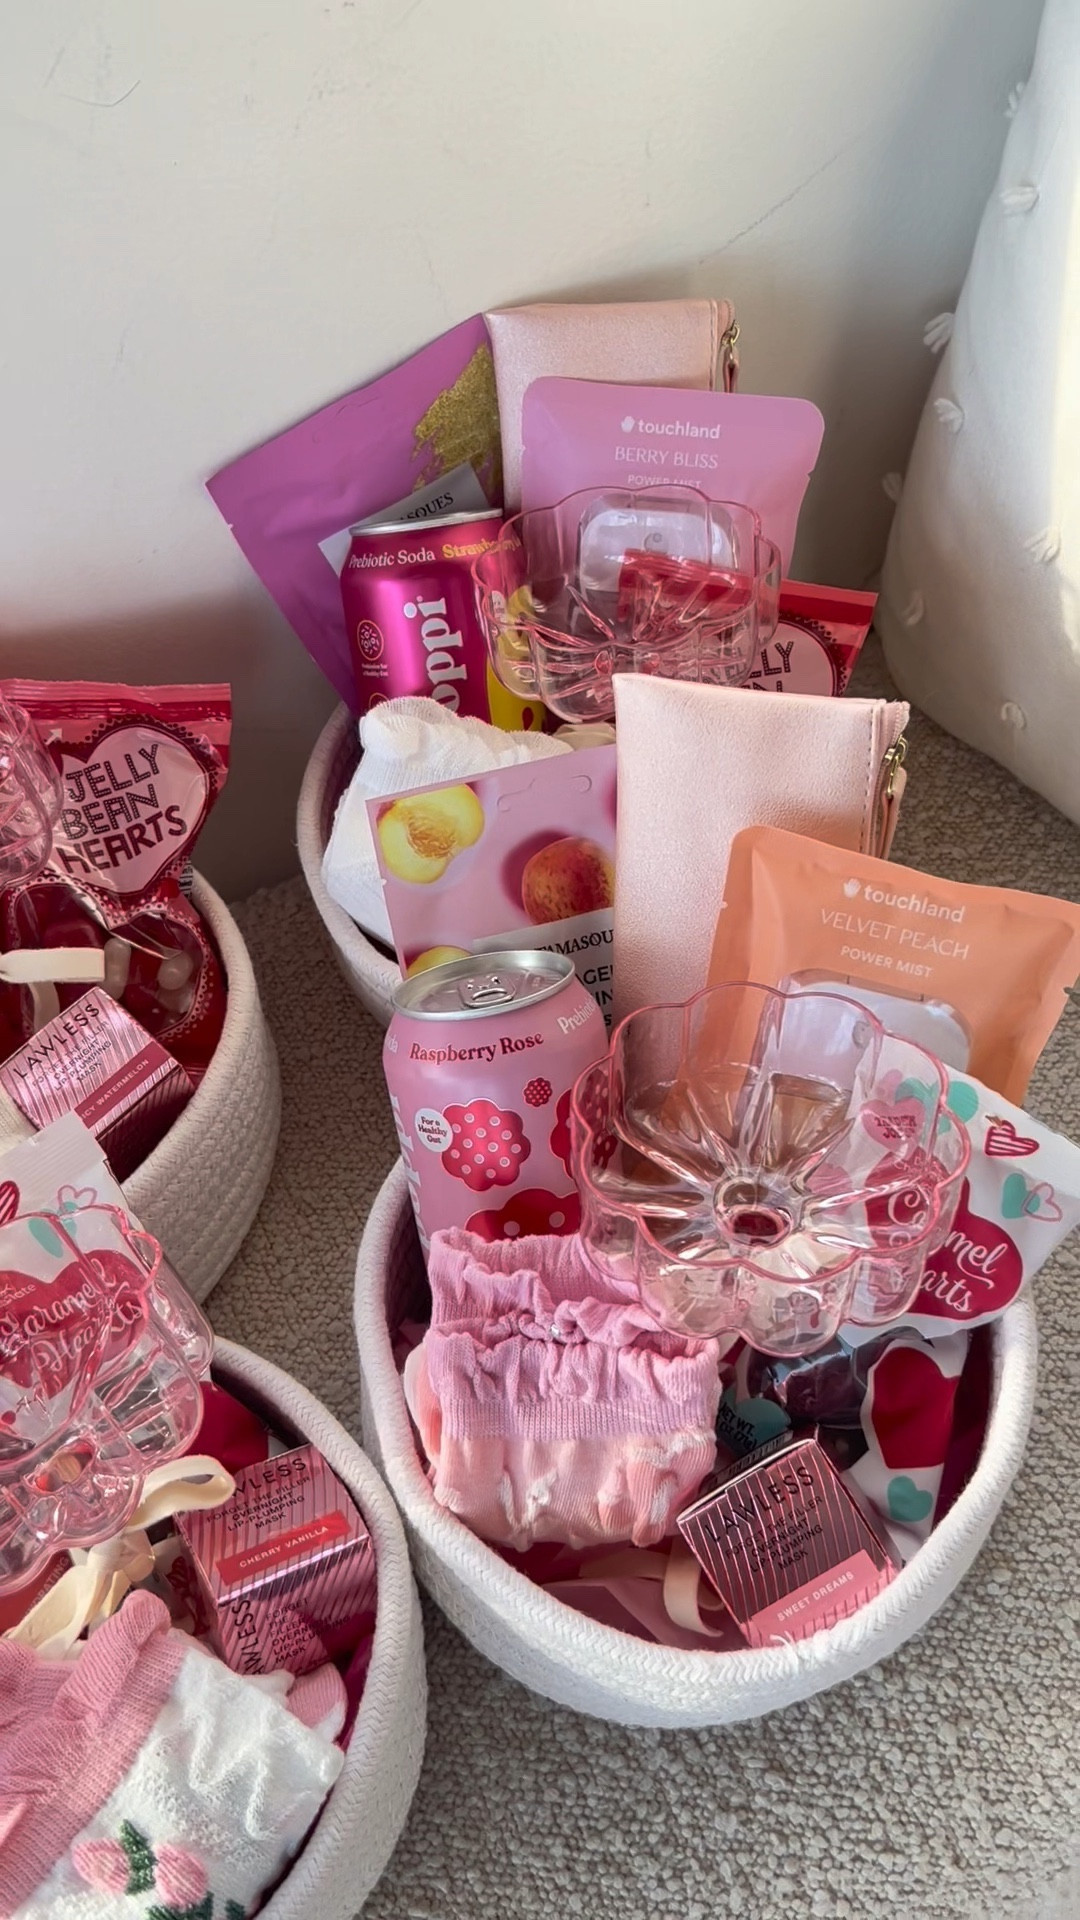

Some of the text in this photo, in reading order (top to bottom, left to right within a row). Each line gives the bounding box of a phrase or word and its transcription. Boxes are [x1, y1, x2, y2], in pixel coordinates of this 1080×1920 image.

[637, 419, 721, 439] touchland
[614, 446, 719, 469] BERRY BLISS
[400, 491, 455, 520] SQUES
[348, 552, 396, 569] Prebiotic
[397, 547, 436, 566] Soda
[65, 743, 160, 802] JELLY
[61, 783, 159, 841] BEAN
[56, 804, 188, 875] HEARTS
[863, 884, 966, 924] touchland
[821, 908, 970, 961] VELVET PEACH
[840, 945, 934, 978] POWER MIST
[12, 1003, 100, 1080] LAWLESS
[53, 1040, 100, 1081] OVERNIGHT
[409, 1042, 498, 1065] Raspberry
[499, 1033, 545, 1055] Rose
[76, 1061, 102, 1083] MASK
[81, 1058, 150, 1120] ICY WATERMELON
[417, 1124, 448, 1138] Healthy
[420, 1115, 434, 1125] For
[426, 1134, 442, 1144] Gut
[232, 1457, 307, 1498] WLESS
[206, 1475, 311, 1523] FORGET THE FILLER
[227, 1495, 306, 1532] LIP-PLUMPING
[232, 1490, 295, 1521] OVERNIGHT
[703, 1466, 814, 1544] LAWLESS
[255, 1512, 288, 1530] MASK
[725, 1496, 823, 1560] FORGET THE FILLER
[750, 1517, 809, 1558] OVERNIGHT
[239, 1526, 329, 1568] CHERRY VANILLA
[777, 1549, 809, 1570] MASK
[776, 1571, 855, 1622] SWEET DREAMS
[275, 1646, 306, 1665] MASK
